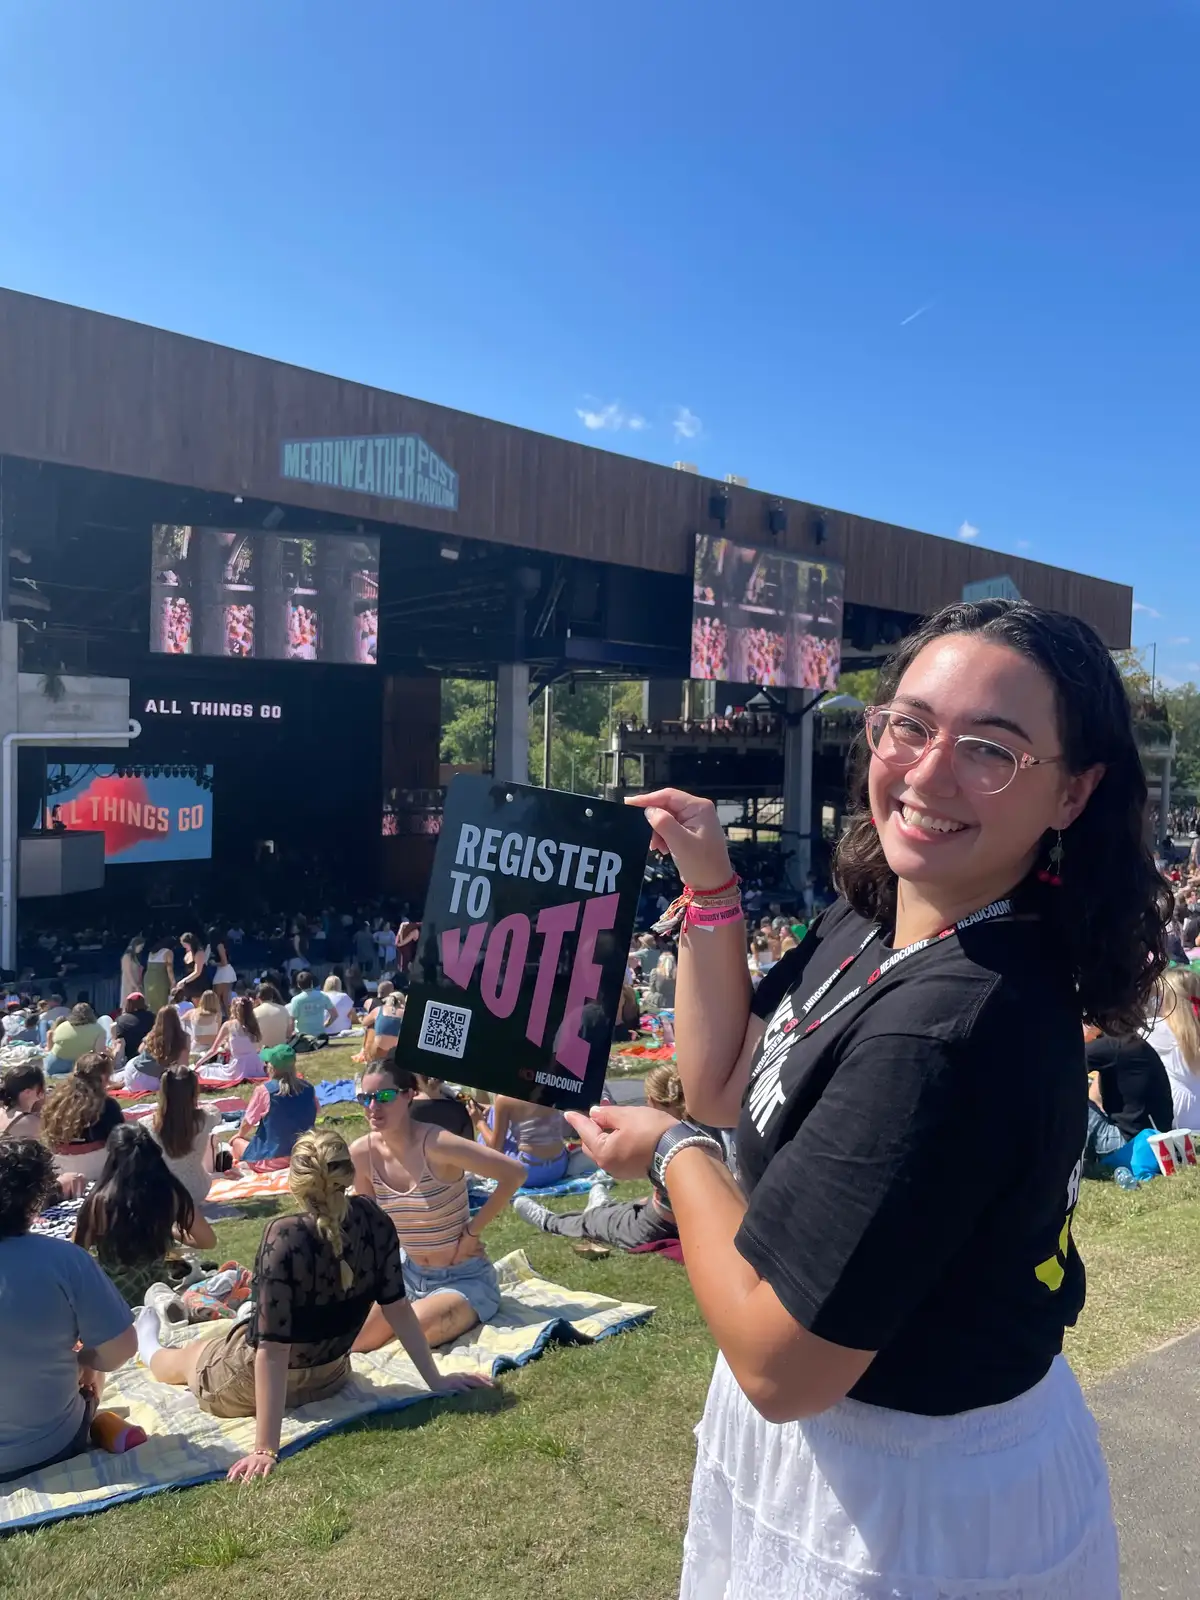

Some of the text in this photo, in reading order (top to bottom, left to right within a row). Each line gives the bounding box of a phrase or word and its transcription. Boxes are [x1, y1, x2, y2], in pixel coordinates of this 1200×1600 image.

[284, 436, 416, 501] MERRIWEATHER
[417, 439, 456, 491] POST
[145, 699, 282, 719] ALL THINGS GO
[89, 796, 170, 832] THINGS
[178, 804, 204, 832] GO
[454, 823, 623, 893] REGISTER
[449, 870, 491, 919] TO
[879, 938, 930, 975] HEADCOUNT
[441, 892, 621, 1081] VOTE
[801, 969, 841, 1014] HEADCOUNT
[534, 1071, 584, 1094] HEADCOUNT
